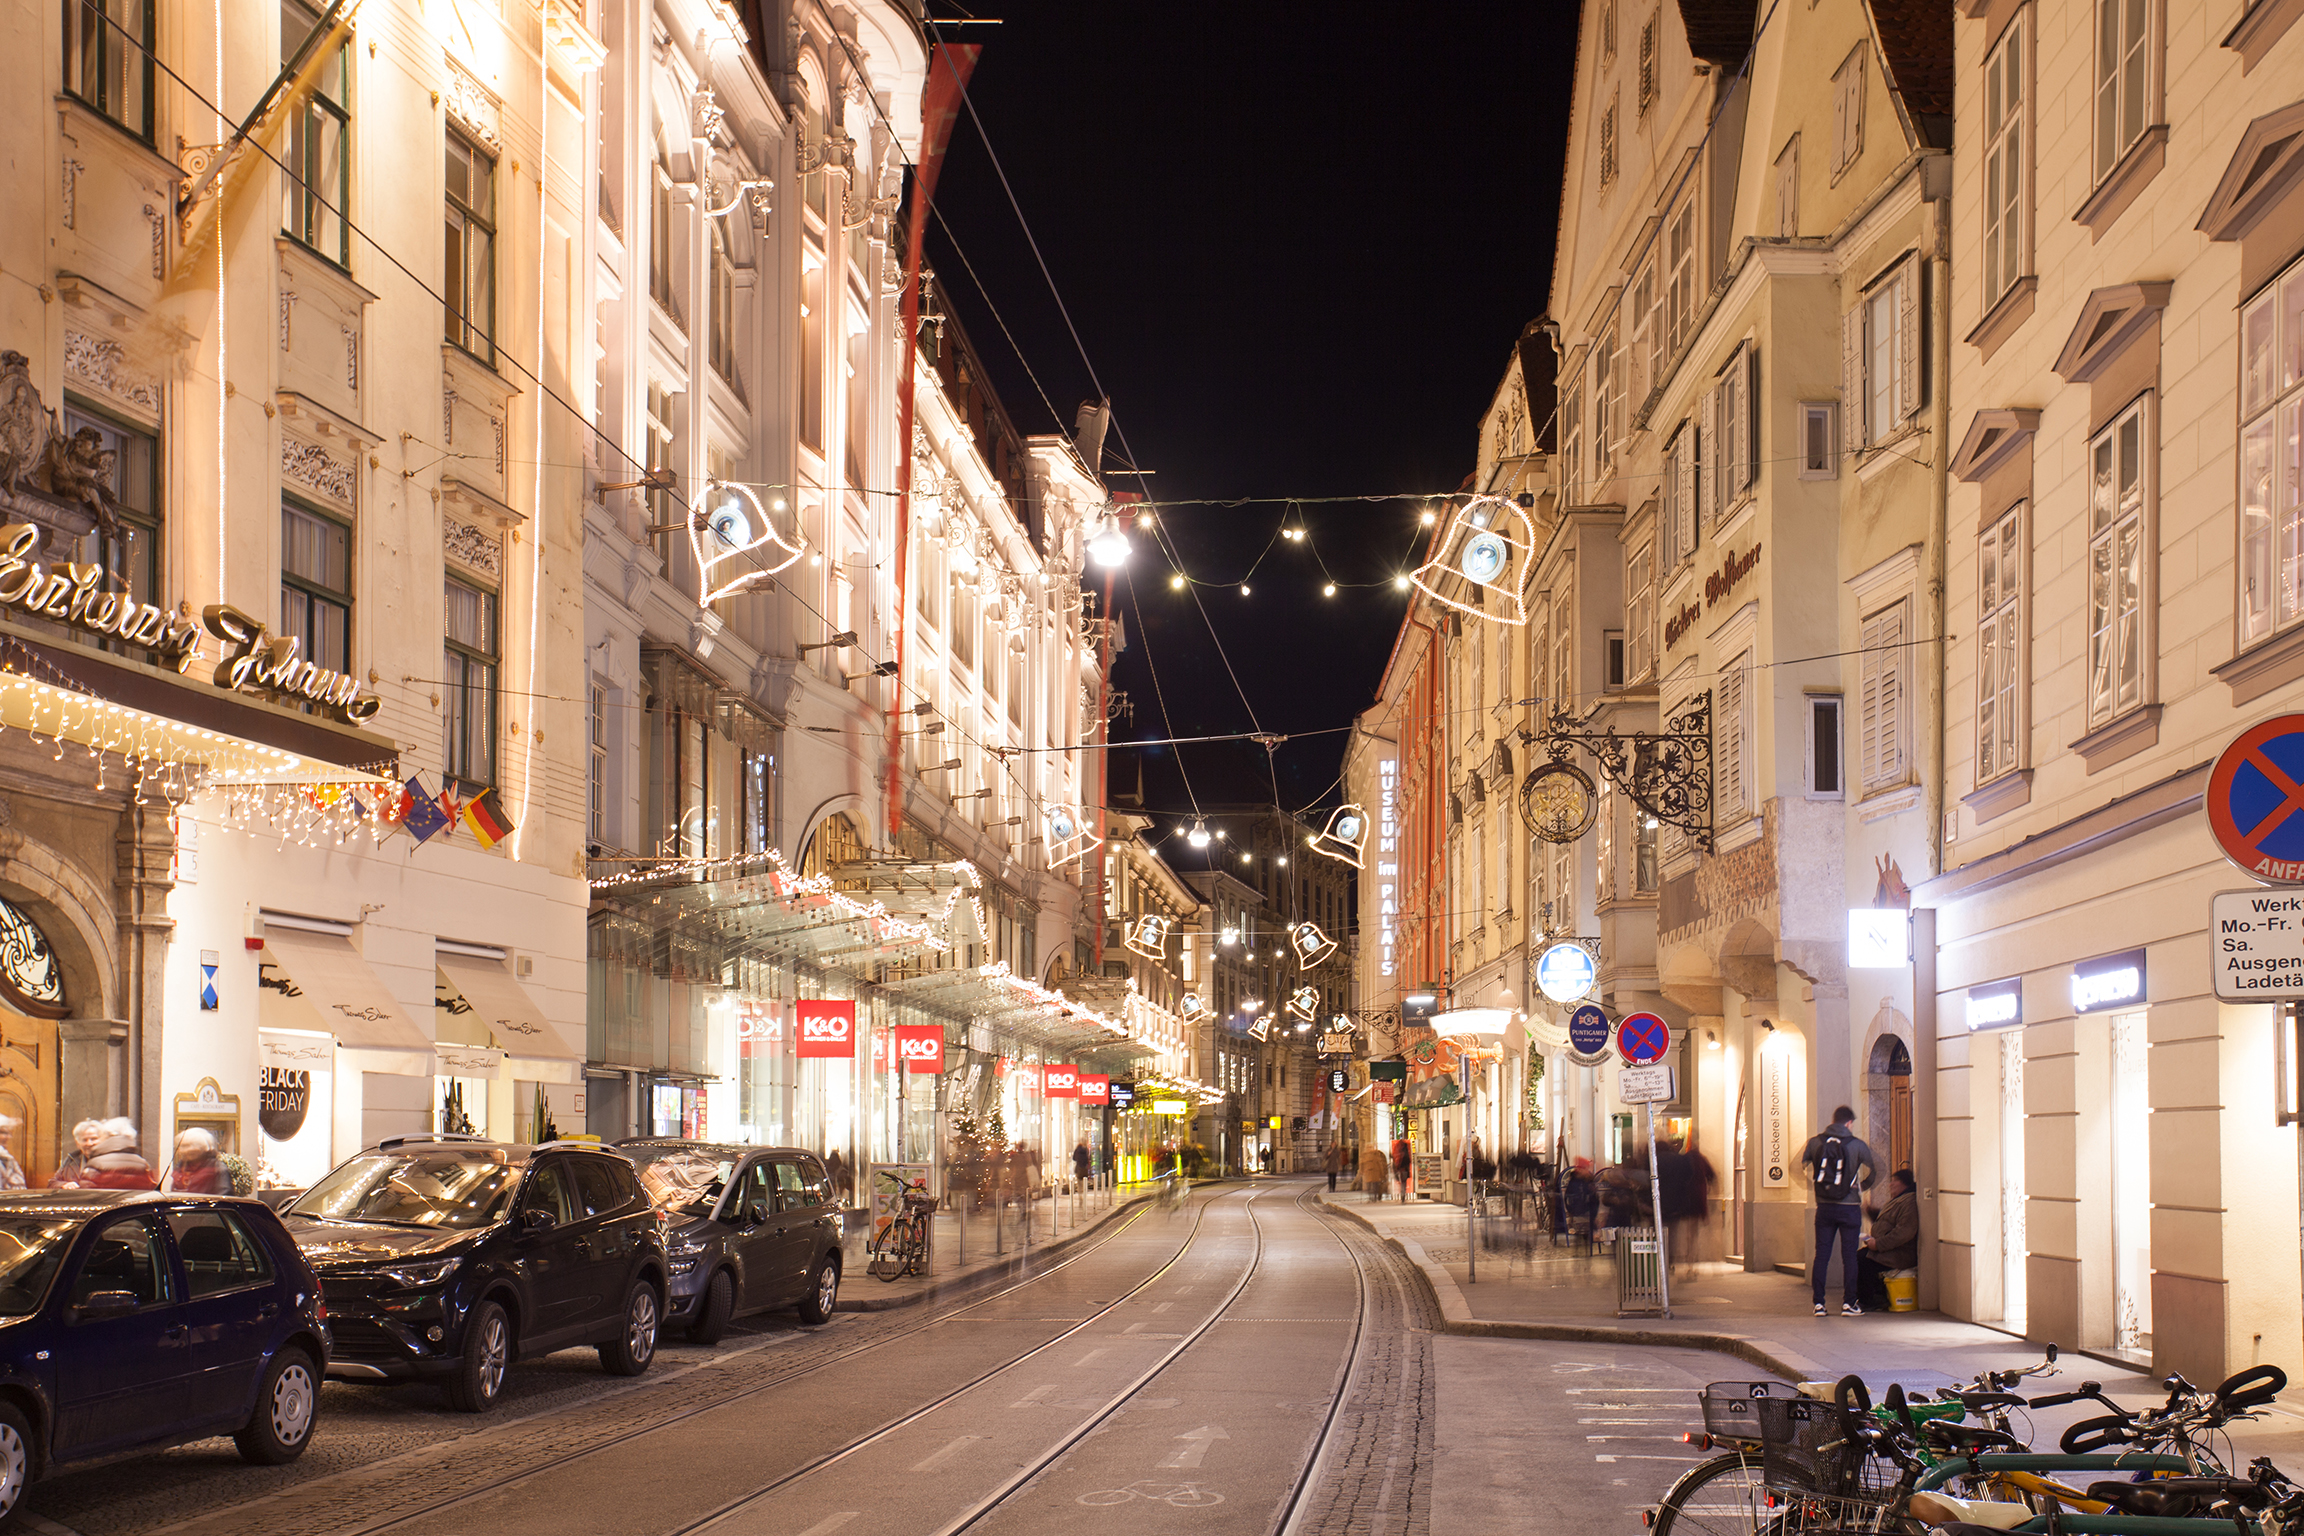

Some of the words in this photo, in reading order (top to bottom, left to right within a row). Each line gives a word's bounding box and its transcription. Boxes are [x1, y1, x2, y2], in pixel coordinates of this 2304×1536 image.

[1665, 592, 1700, 652] Bäckerei
[1705, 542, 1762, 608] Wolfbauer
[0, 523, 206, 674] Erzherzog
[204, 604, 382, 726] Johann
[1380, 760, 1396, 852] MUSEUM
[192, 823, 198, 839] 3
[192, 854, 198, 871] 5
[1378, 860, 1396, 876] im
[2251, 897, 2304, 913] Werk
[1380, 883, 1396, 976] PALAIS
[2222, 938, 2253, 952] Sa.
[2227, 957, 2304, 972] Ausgen
[260, 1066, 305, 1089] BLACK
[1625, 1086, 1665, 1095] Ausgenommen
[260, 1090, 305, 1112] FRIDAY
[1771, 1118, 1780, 1163] Bäckerei
